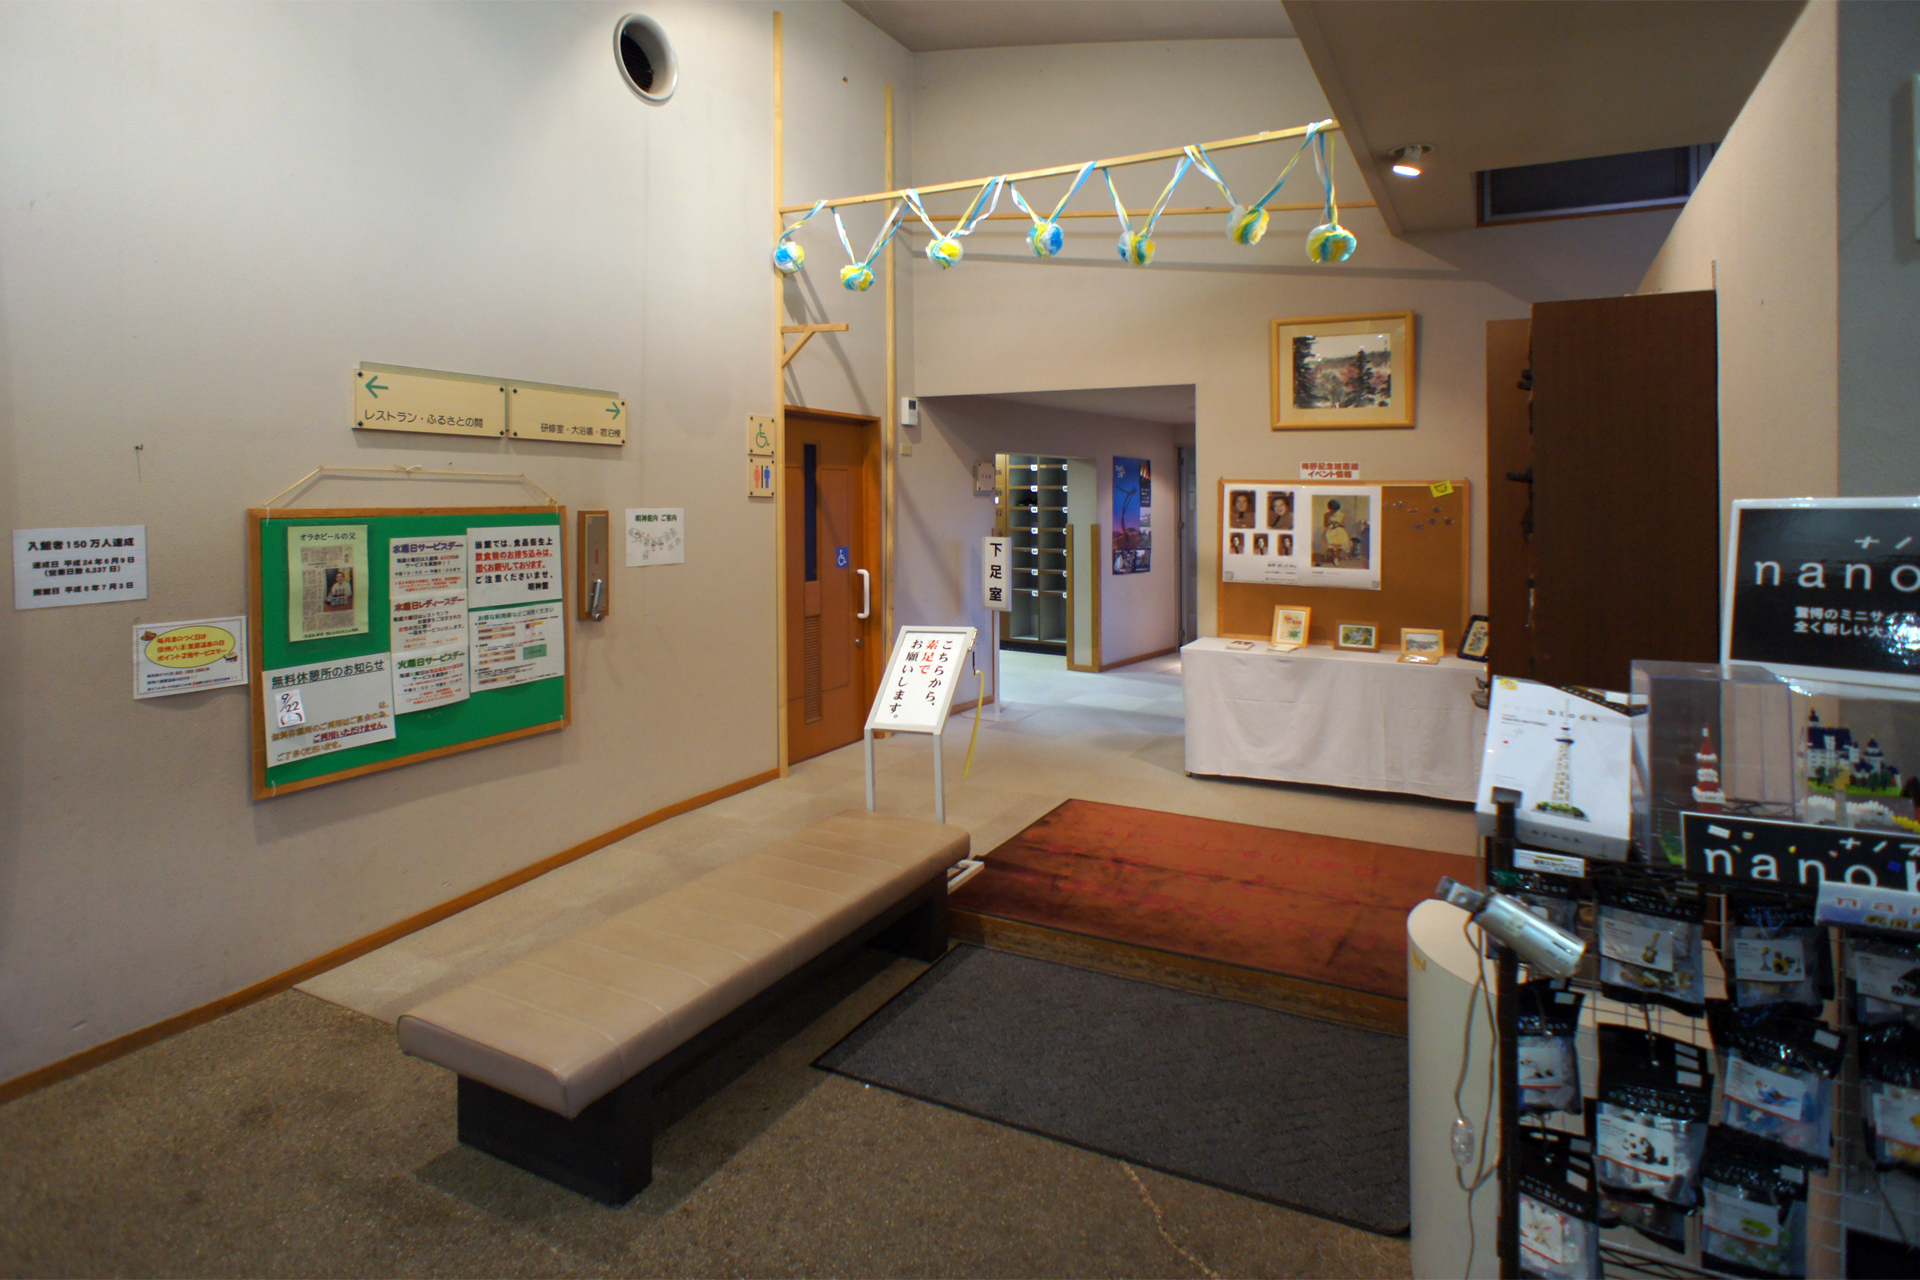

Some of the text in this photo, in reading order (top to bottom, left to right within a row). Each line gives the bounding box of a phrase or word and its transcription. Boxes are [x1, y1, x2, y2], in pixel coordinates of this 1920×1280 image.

[364, 409, 483, 428] レストラン・ふるさとの間
[28, 537, 134, 551] 入館者150万人達成
[300, 532, 356, 541] オラホビールの父
[393, 541, 464, 554] 水曜日サービスデー
[989, 542, 1003, 602] 下足室
[394, 596, 465, 612] 木曜日レディースデー
[397, 651, 465, 669] 火曜日サービスデー
[919, 639, 940, 675] 素足で
[272, 659, 384, 689] 無料休憩所のお知らせ
[889, 639, 923, 719] お願いします。
[925, 640, 953, 706] こちらから、
